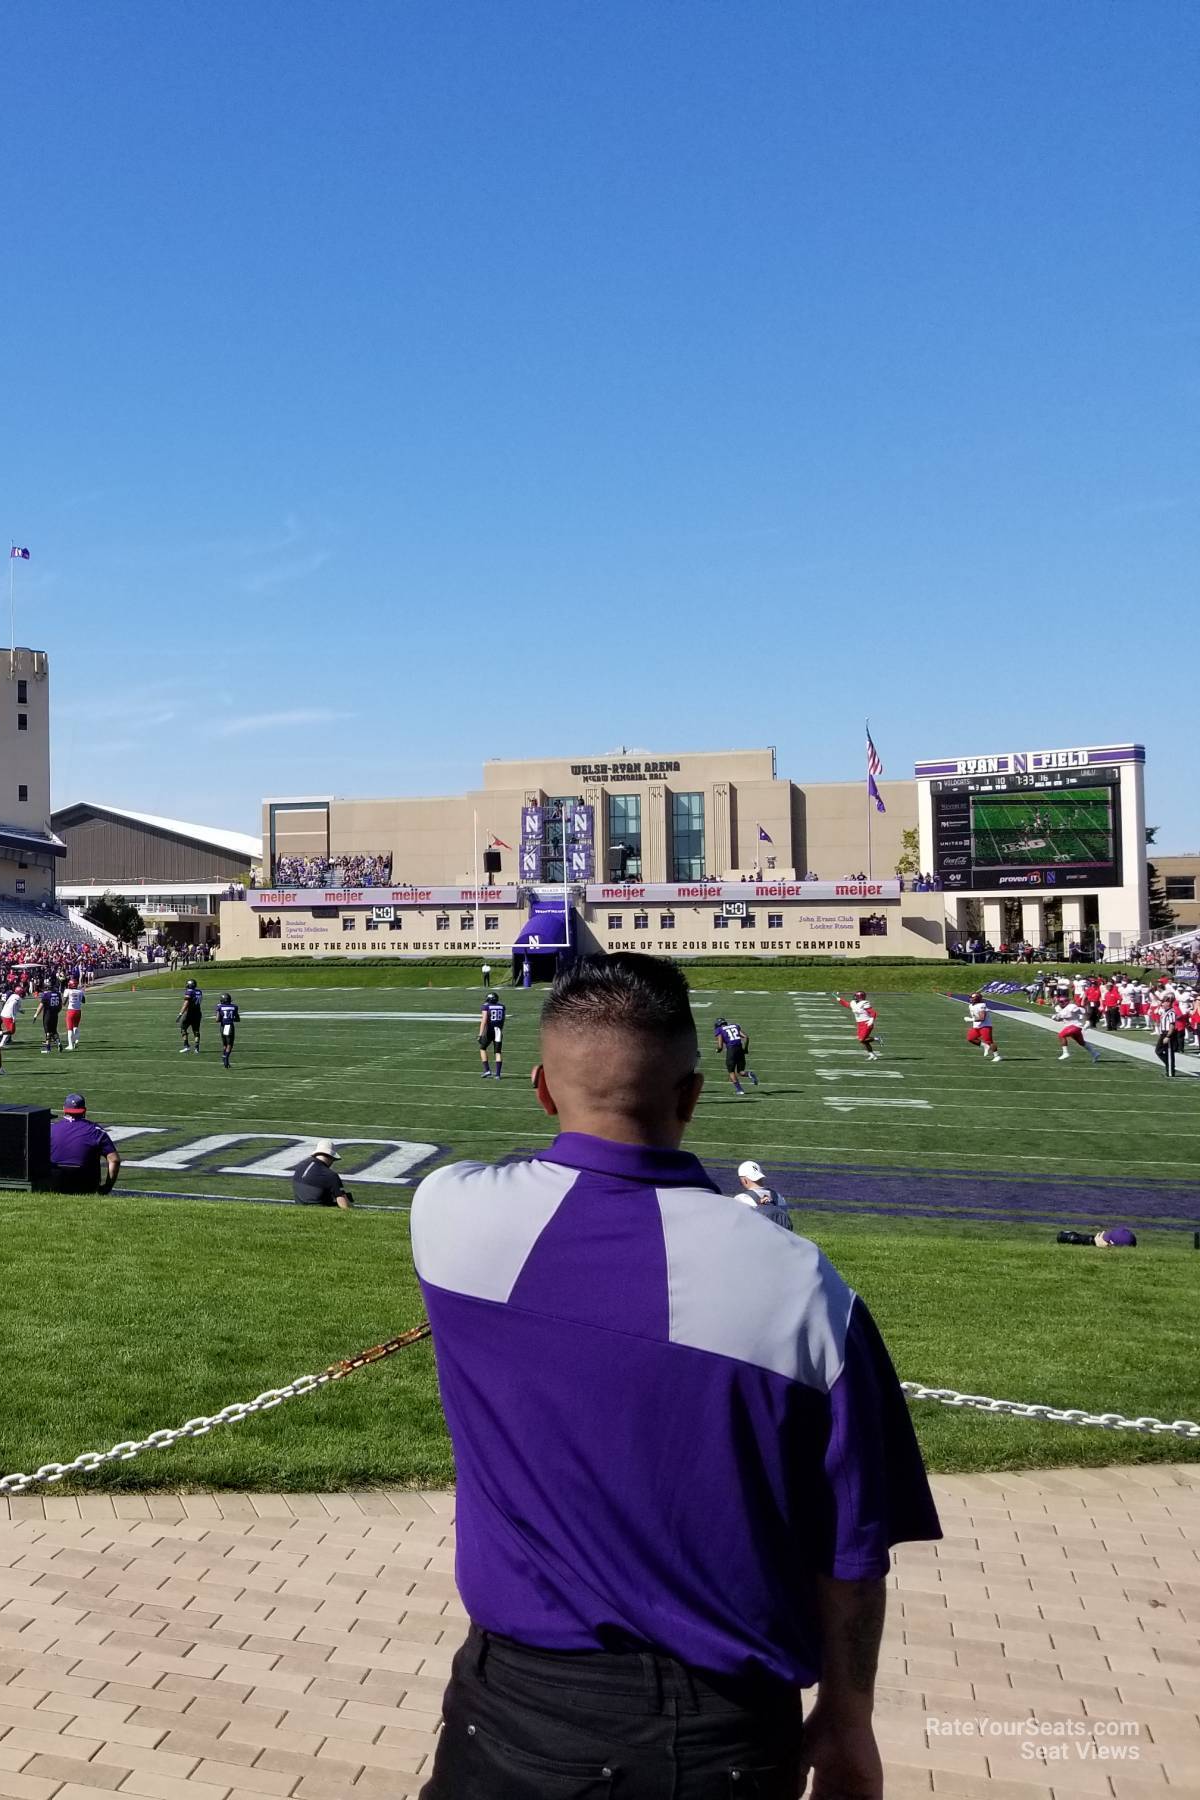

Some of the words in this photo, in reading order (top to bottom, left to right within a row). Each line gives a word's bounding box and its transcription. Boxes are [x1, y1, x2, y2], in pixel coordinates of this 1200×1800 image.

[570, 762, 641, 776] WELSH-RYAN
[644, 762, 680, 772] ARENA
[956, 758, 998, 774] RYAN
[1012, 754, 1028, 774] N
[1040, 750, 1089, 768] FIELD
[610, 773, 647, 782] MEMORIAL
[648, 772, 668, 780] HALL
[936, 782, 942, 791] 7
[1015, 775, 1034, 786] 7:33
[1112, 768, 1118, 778] 7
[526, 815, 538, 832] N
[574, 814, 587, 832] N
[524, 853, 536, 870] N
[572, 852, 586, 870] N
[259, 889, 298, 904] meijer
[324, 888, 364, 904] meijer
[391, 888, 432, 903] meijer
[460, 887, 502, 902] meijer
[602, 885, 646, 900] meijer
[677, 884, 722, 900] meijer
[755, 883, 801, 898] meijer
[835, 882, 883, 898] meijer
[375, 906, 391, 918] 40
[726, 902, 742, 914] 40
[281, 942, 304, 950] HOME
[308, 942, 320, 950] OF
[323, 942, 341, 950] THE
[345, 942, 367, 950] 2018
[371, 942, 387, 950] BIG
[391, 942, 408, 950] TEN
[413, 942, 440, 950] WEST
[528, 935, 540, 949] N
[608, 942, 636, 950] HOME
[640, 942, 652, 950] OF
[656, 941, 678, 950] THE
[682, 941, 708, 950] 2018
[712, 941, 730, 949] BIG
[734, 940, 756, 949] TEN
[760, 940, 790, 949] WEST
[796, 940, 861, 949] CHAMPIONS
[726, 1028, 740, 1040] 12
